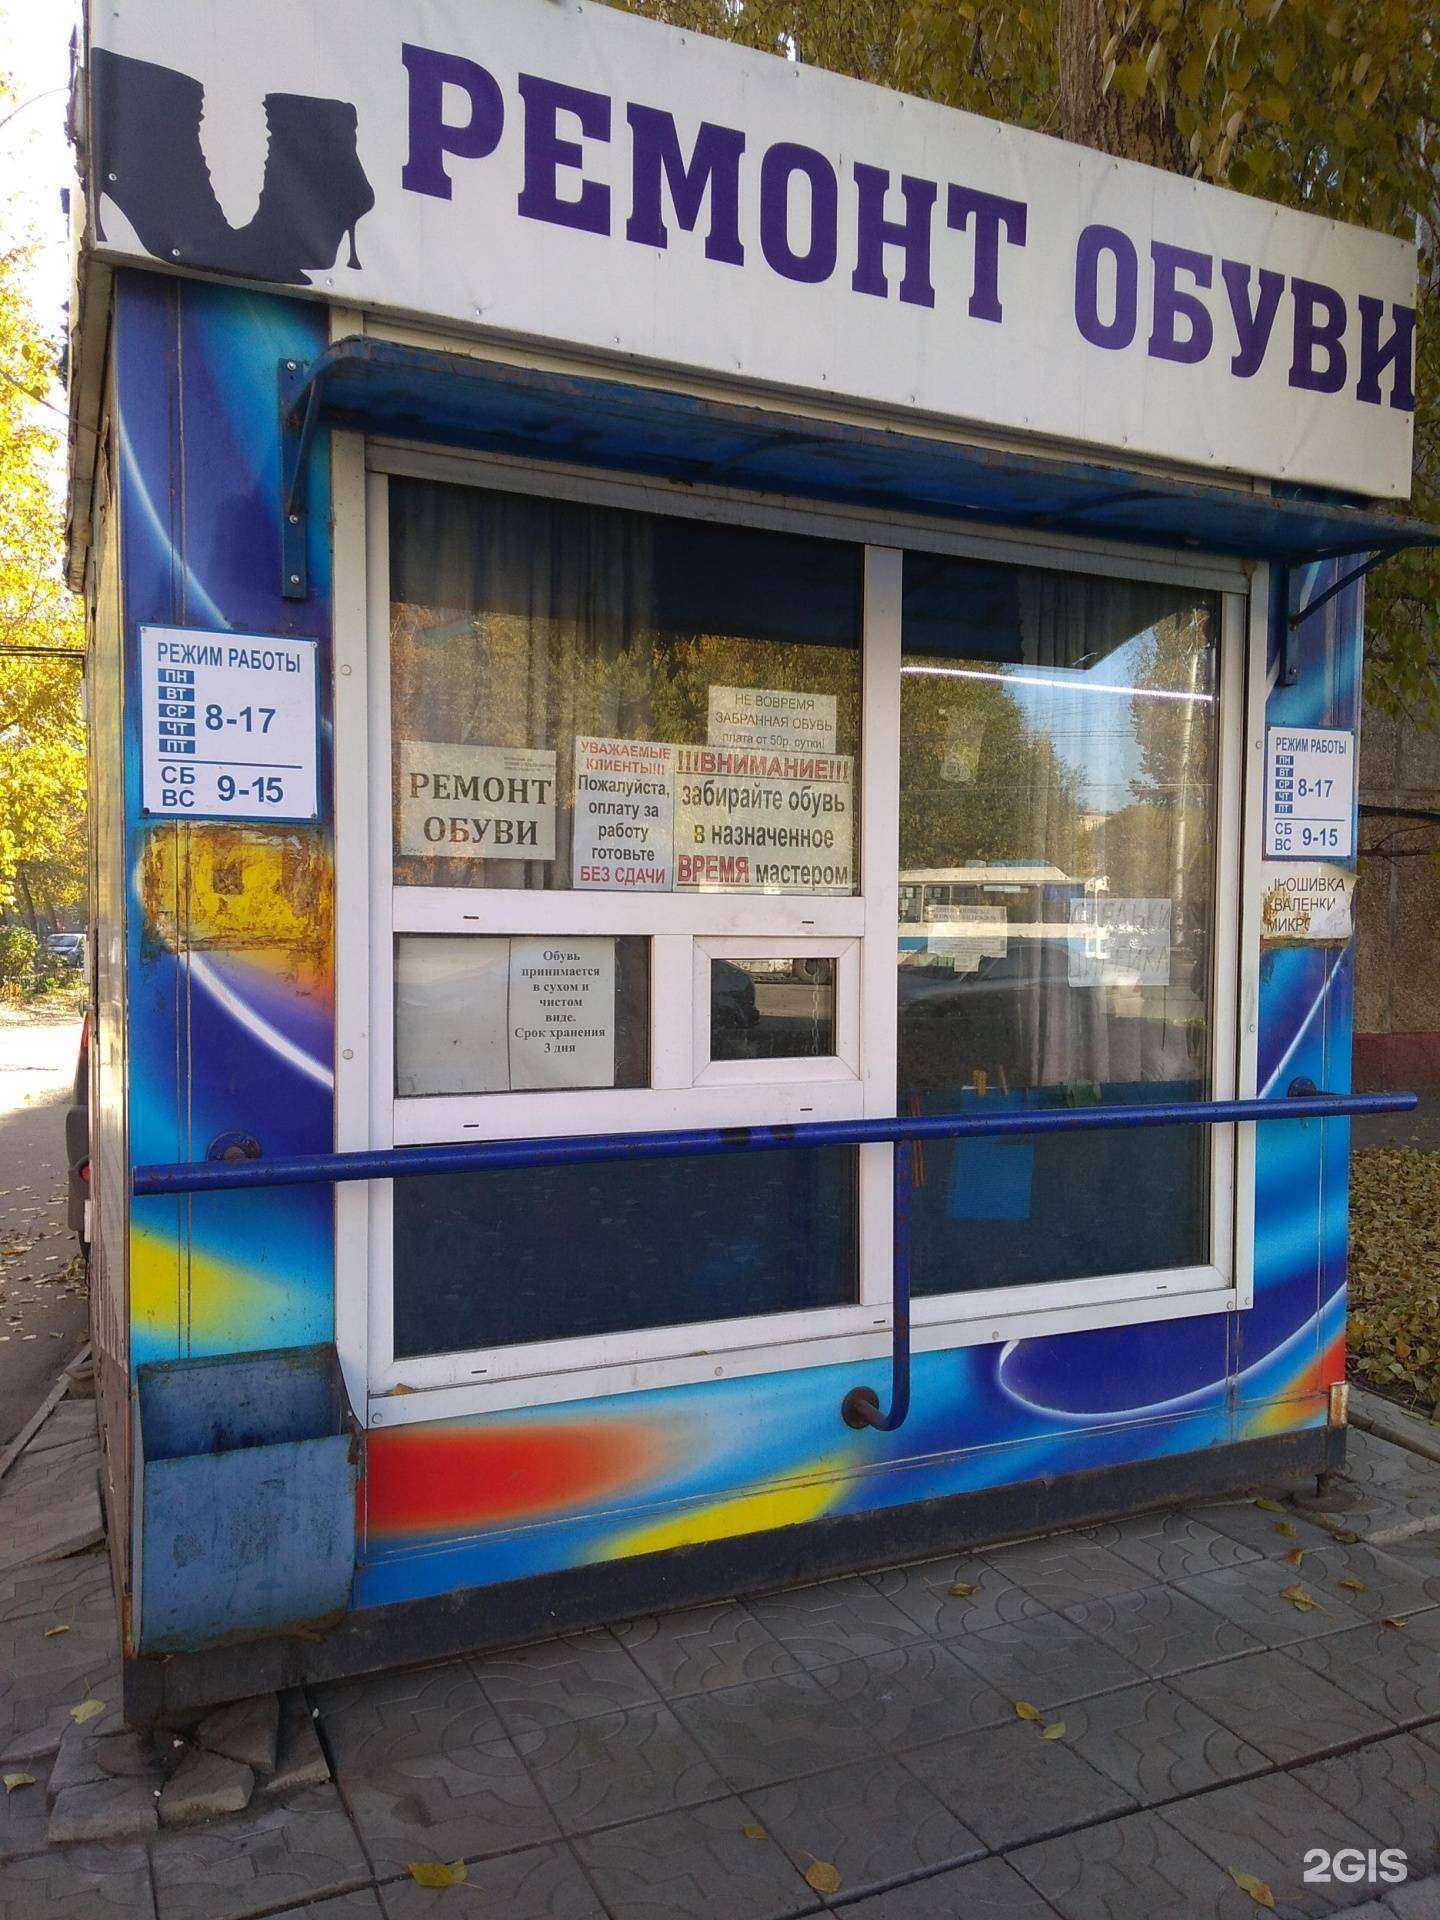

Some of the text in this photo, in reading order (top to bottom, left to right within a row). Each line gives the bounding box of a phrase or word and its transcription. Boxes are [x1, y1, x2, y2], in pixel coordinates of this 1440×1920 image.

[401, 42, 1415, 412] РЕМОНТ ОБУВИ
[158, 642, 301, 673] РЕЖИМ РАБОТЫ
[165, 670, 187, 682] ПН
[166, 688, 186, 700] ВТ
[735, 694, 815, 711] НЕ ВОВРЕМЯ
[166, 706, 188, 716] СР
[205, 704, 276, 733] 8-17
[166, 723, 187, 735] ЧТ
[715, 711, 832, 732] ЗАБРАННАЯ ОБУВЬ
[166, 740, 186, 752] ПТ
[722, 733, 753, 744] плата
[756, 736, 767, 744] от
[1276, 737, 1346, 754] РЕЖИМ РАБОТЫ
[581, 741, 671, 760] УВАЖАЕМЫЕ
[586, 757, 665, 776] КЛИЕНТЫ!!!
[677, 750, 849, 780] !!!ВНИМАНИЕ!!!
[161, 766, 195, 785] СБ
[217, 775, 283, 803] 9-15
[409, 772, 552, 805] РЕМОНТ
[578, 774, 670, 798] Пожалуйста,
[1298, 778, 1334, 798] 8-17
[162, 789, 195, 808] ВС
[682, 779, 845, 818] забирайте обувь
[589, 802, 659, 820] оплату за
[423, 816, 538, 846] ОБУВИ
[598, 823, 649, 843] работу
[694, 824, 834, 848] в назначенное
[1275, 822, 1292, 835] СБ
[1302, 827, 1338, 846] 9-15
[1275, 838, 1292, 851] ВС
[591, 847, 655, 862] готовьте
[580, 866, 666, 886] БЕЗ СДАЧИ
[677, 854, 848, 891] ВРЕМЯ мастером
[543, 951, 581, 963] Обувь
[520, 967, 600, 979] принимается
[533, 984, 589, 994] в сухом и
[539, 999, 583, 1007] чистом
[545, 1014, 577, 1023] виде.
[514, 1028, 606, 1040] Срок хранения
[544, 1043, 576, 1053] 3 дня
